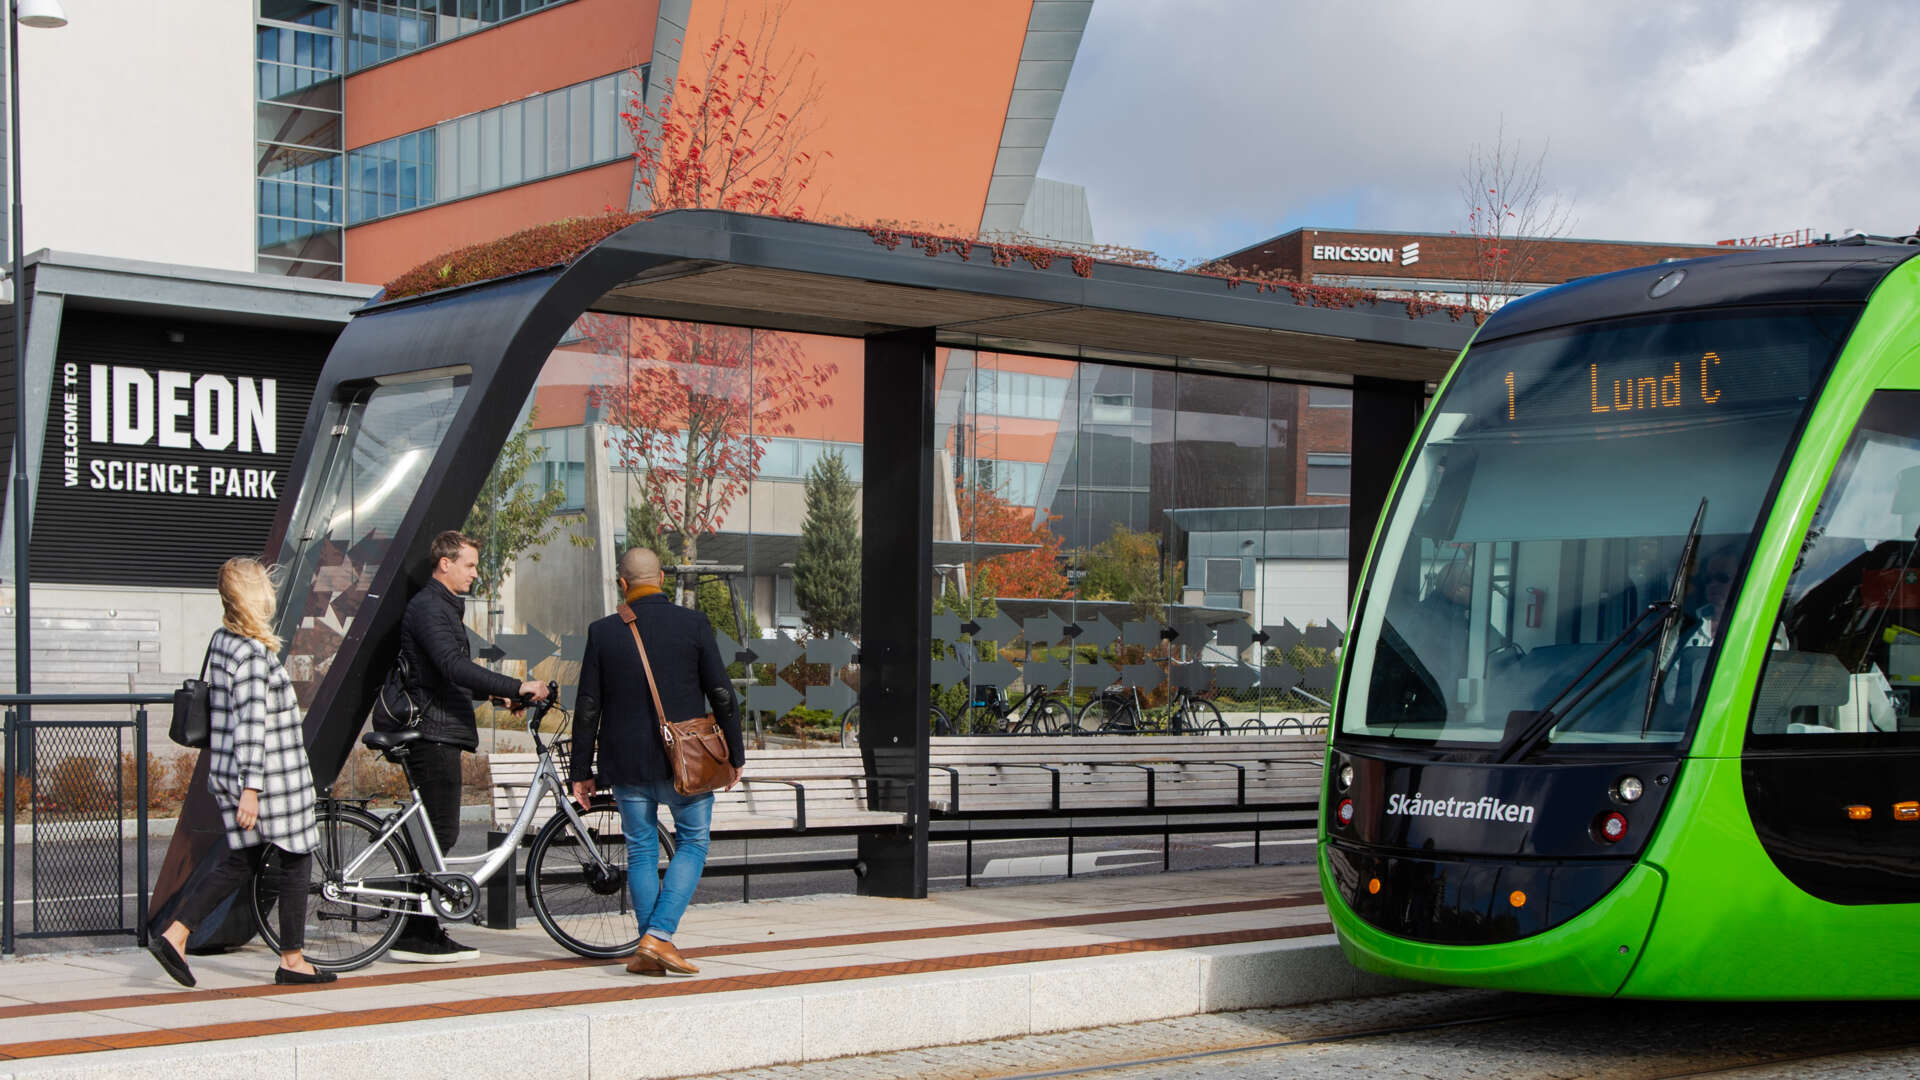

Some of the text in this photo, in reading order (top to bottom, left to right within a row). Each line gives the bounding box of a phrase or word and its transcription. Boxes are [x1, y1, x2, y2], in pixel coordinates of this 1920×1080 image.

[1313, 245, 1393, 262] ERICSSON
[90, 364, 277, 454] IDEON
[1505, 352, 1721, 420] 1 Lund C
[64, 363, 79, 487] WELCOME TO
[90, 459, 277, 499] SCIENCE PARK
[1386, 792, 1535, 823] Skånetrafiken
